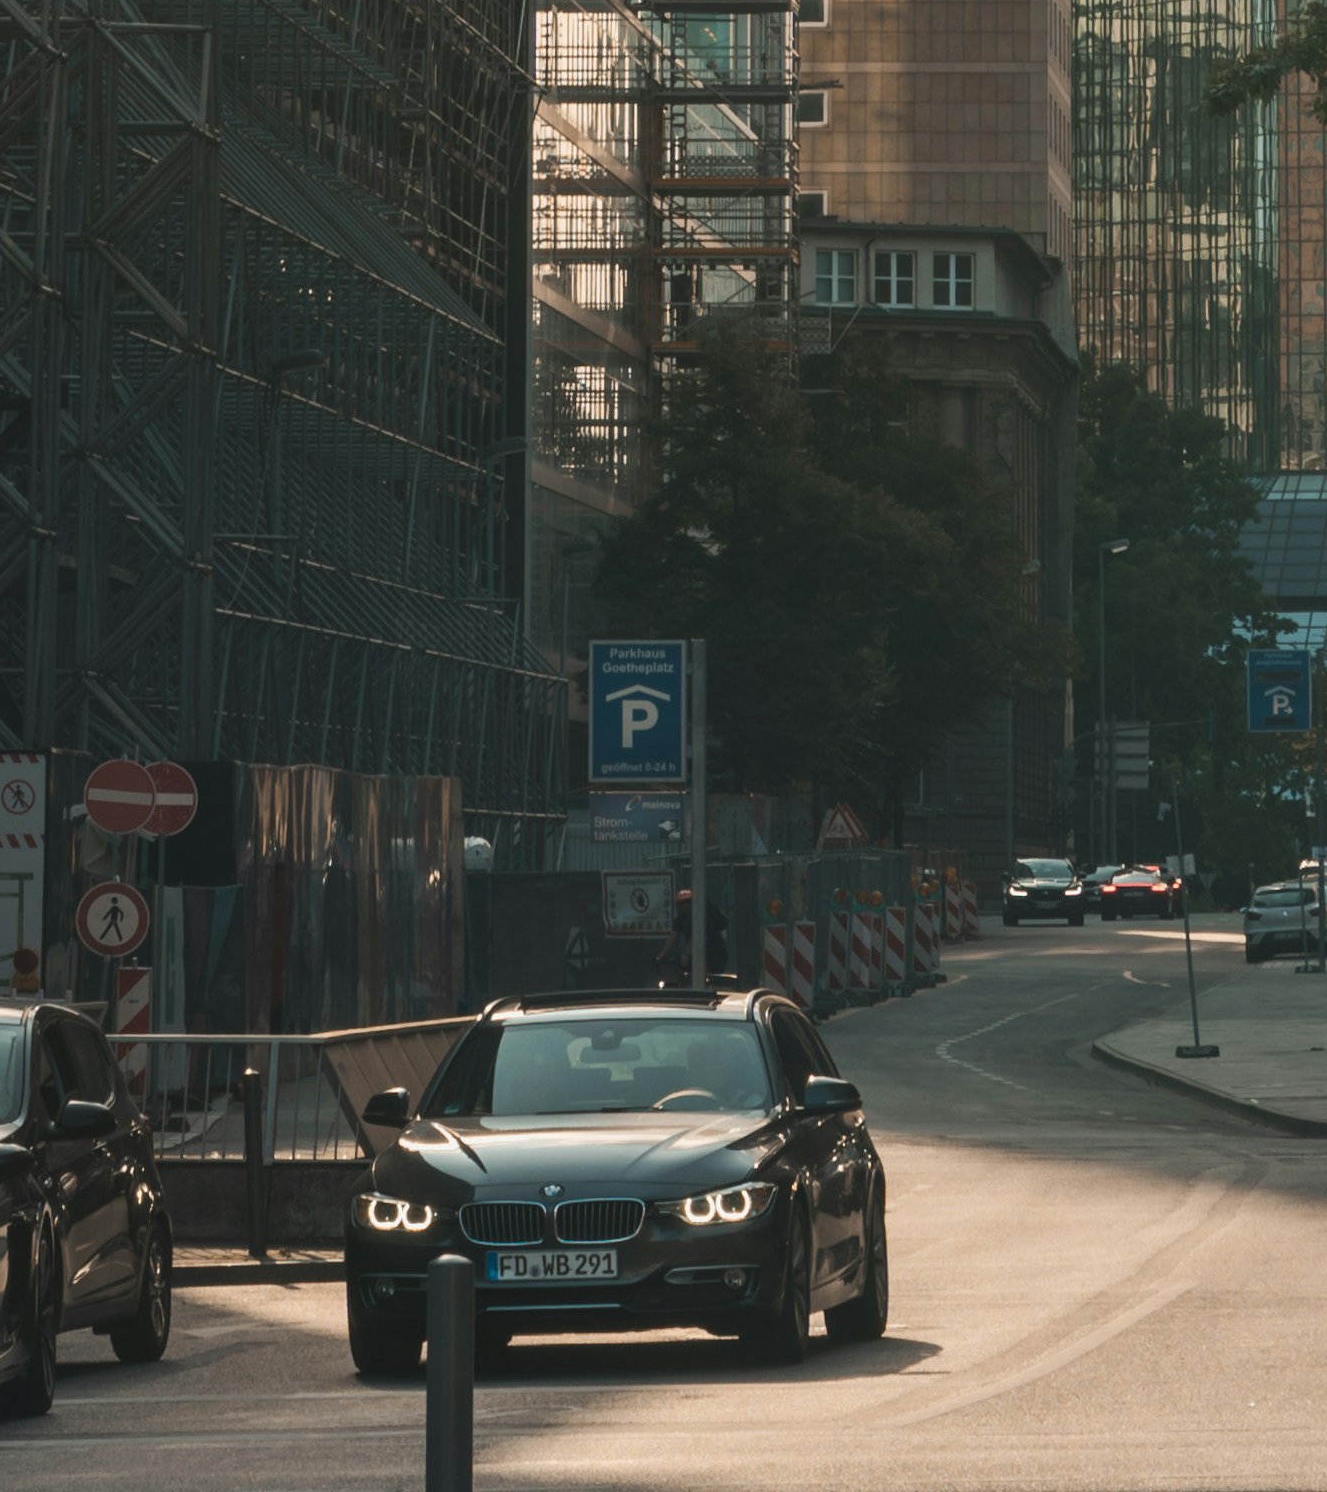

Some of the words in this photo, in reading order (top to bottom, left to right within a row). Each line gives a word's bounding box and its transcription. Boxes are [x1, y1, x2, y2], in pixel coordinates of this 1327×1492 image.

[609, 647, 667, 659] Parkhaus
[602, 661, 675, 675] Goetheplatz
[621, 699, 659, 749] P
[601, 762, 643, 774] geöffnet
[669, 762, 676, 772] h
[641, 801, 681, 810] mainova
[593, 815, 633, 828] Strom-
[593, 830, 649, 842] tankstelle
[499, 1255, 528, 1277] FD
[542, 1254, 571, 1277] WB
[574, 1252, 615, 1275] 291
